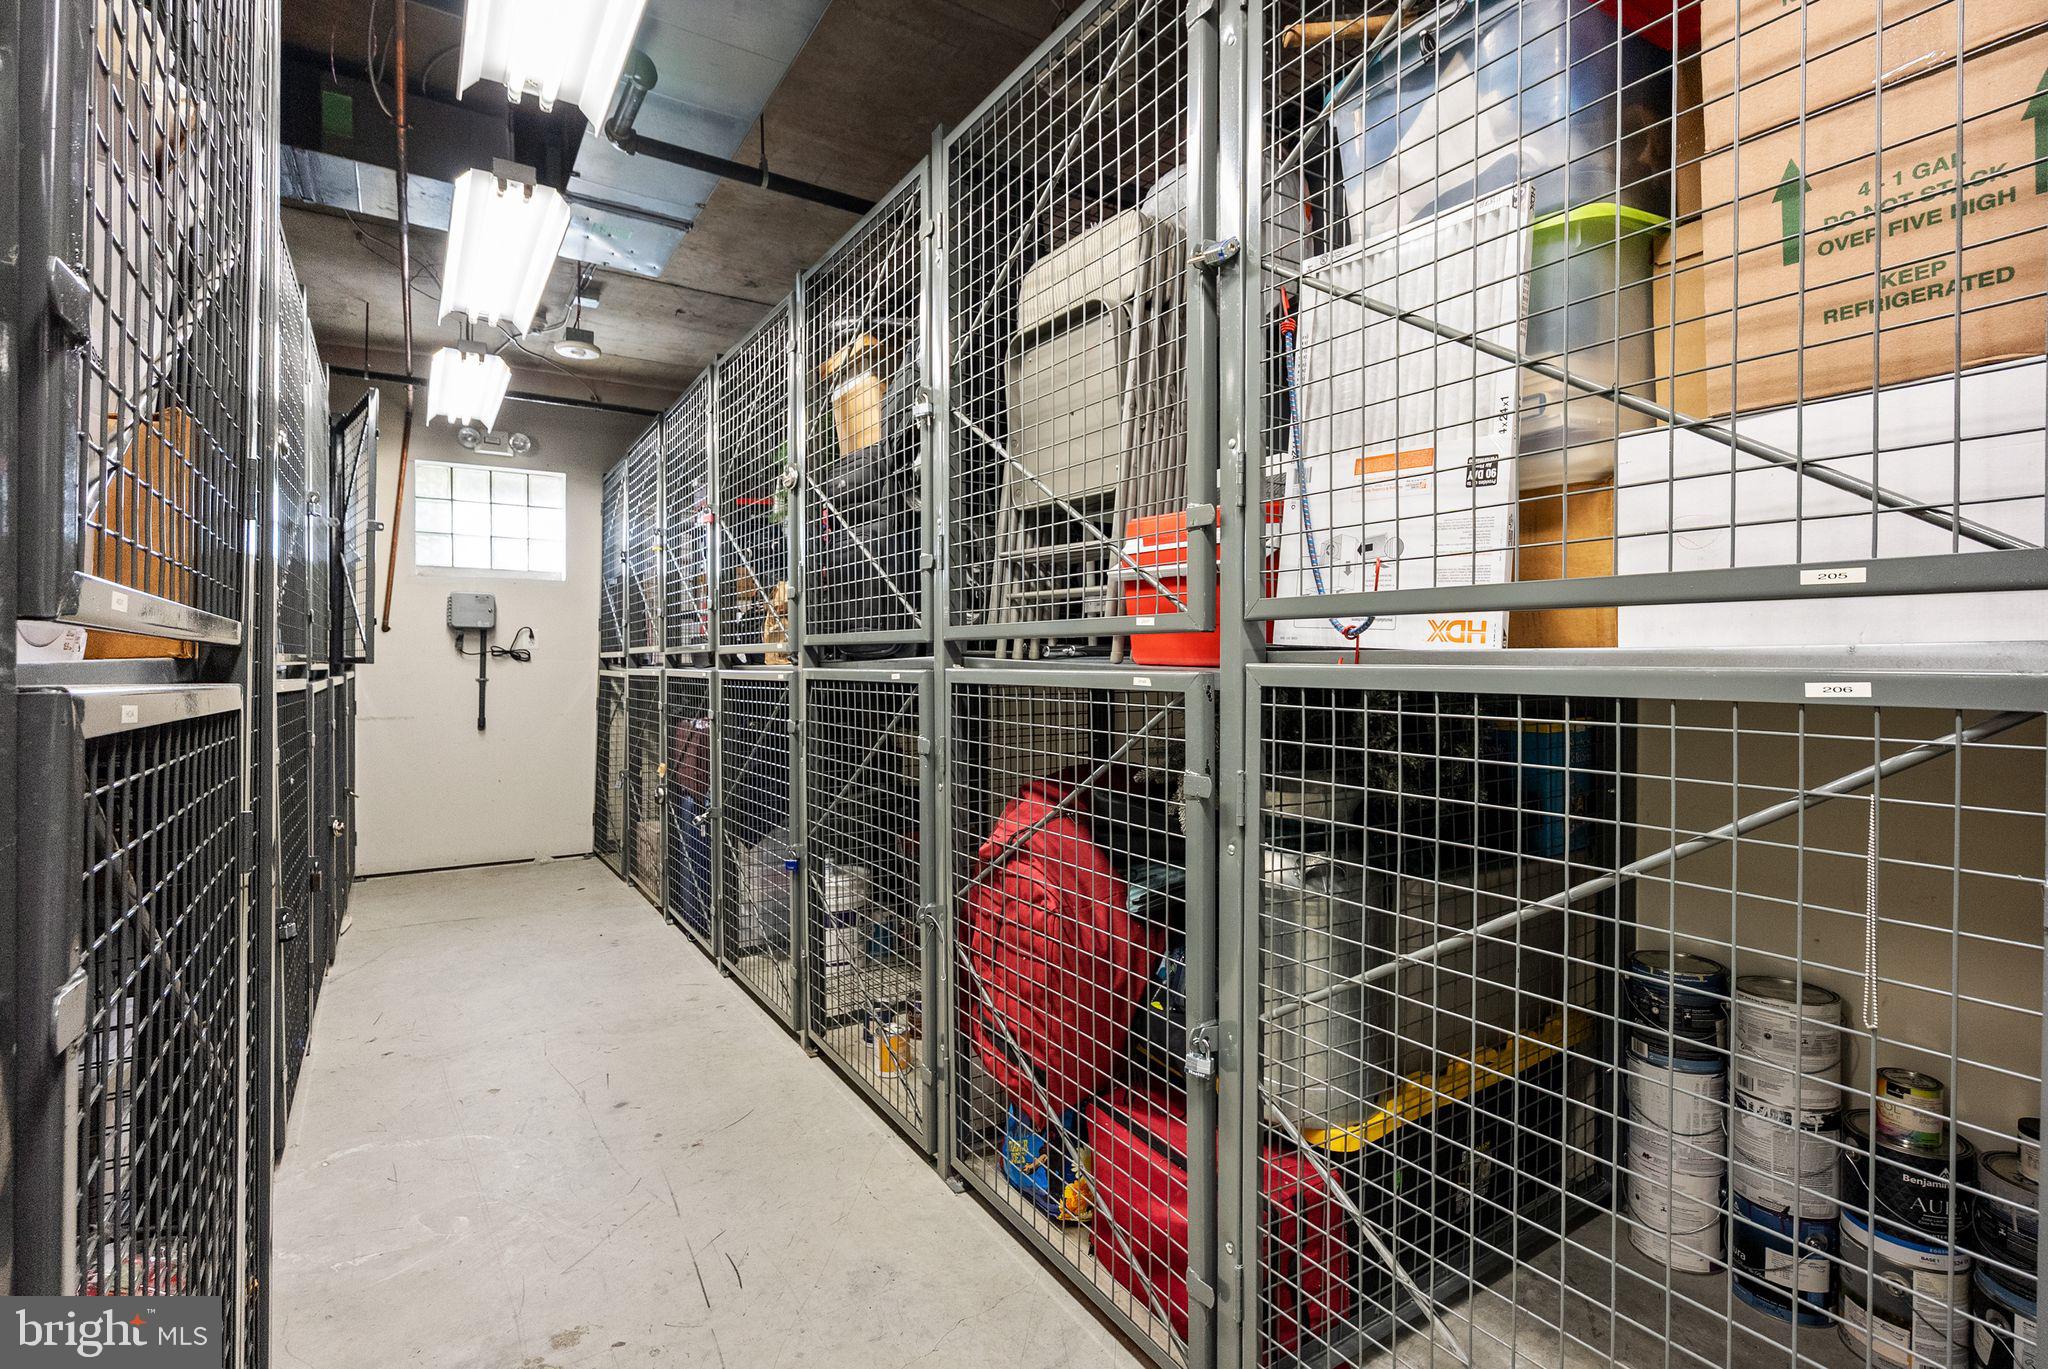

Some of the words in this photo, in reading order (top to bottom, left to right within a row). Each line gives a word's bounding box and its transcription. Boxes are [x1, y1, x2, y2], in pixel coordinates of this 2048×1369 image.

[1823, 210, 1857, 232] DO
[1920, 162, 2009, 202] STCK
[1858, 181, 1870, 196] 4
[1893, 170, 1902, 186] 1
[1888, 207, 1943, 237] FIVE
[1951, 186, 2017, 219] HIGH
[1881, 260, 1947, 290] KEEP
[1823, 265, 2016, 325] REFRIGERATED
[1485, 468, 1497, 479] 90
[1818, 572, 1848, 580] 205
[1427, 619, 1487, 644] HDX
